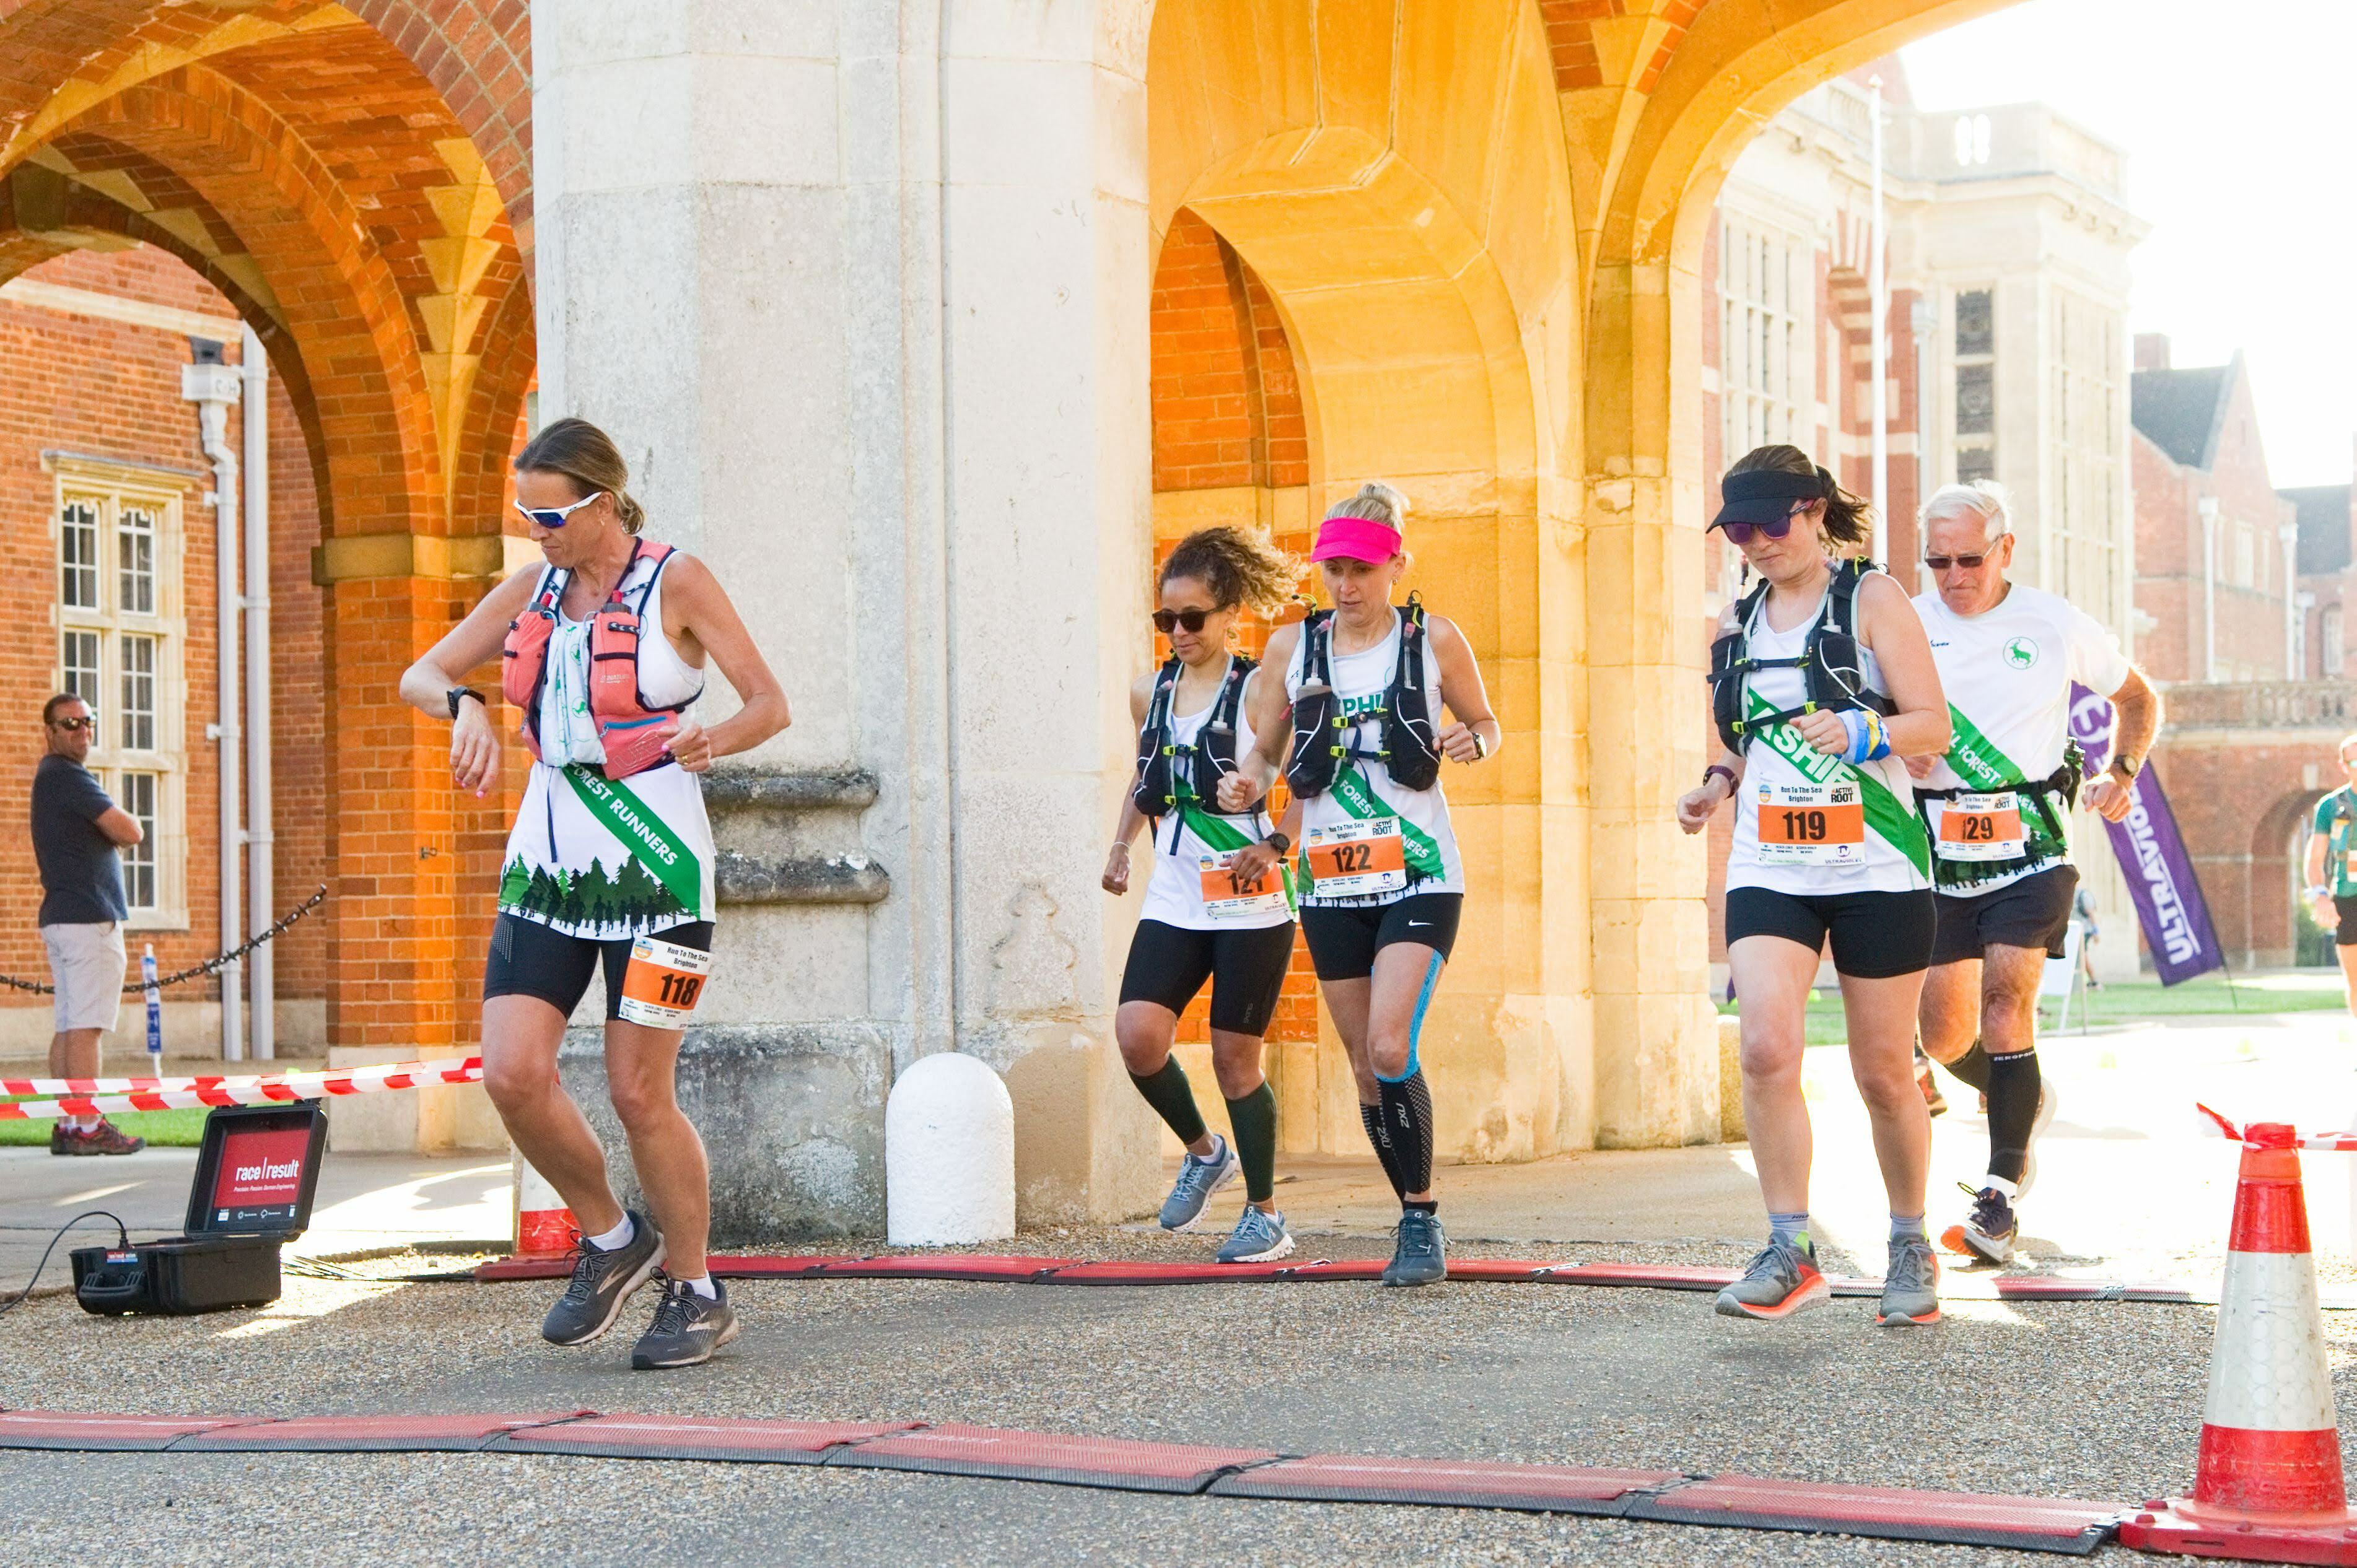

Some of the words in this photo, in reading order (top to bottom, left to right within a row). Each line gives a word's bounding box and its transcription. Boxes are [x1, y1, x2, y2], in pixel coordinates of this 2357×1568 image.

[1958, 744, 2001, 785] FOREST
[1830, 793, 1853, 803] ROOT
[609, 798, 678, 866] RUNNERS
[1339, 779, 1377, 819] FOREST
[1402, 834, 1430, 859] NERS
[1373, 826, 1393, 835] ROOT
[1782, 811, 1826, 840] 119
[1331, 843, 1372, 873] 122
[667, 947, 679, 955] Run
[688, 952, 697, 960] The
[697, 954, 708, 962] Sea
[673, 957, 698, 969] Brighton
[660, 973, 699, 1006] 118
[1395, 1102, 1410, 1128] 2XU
